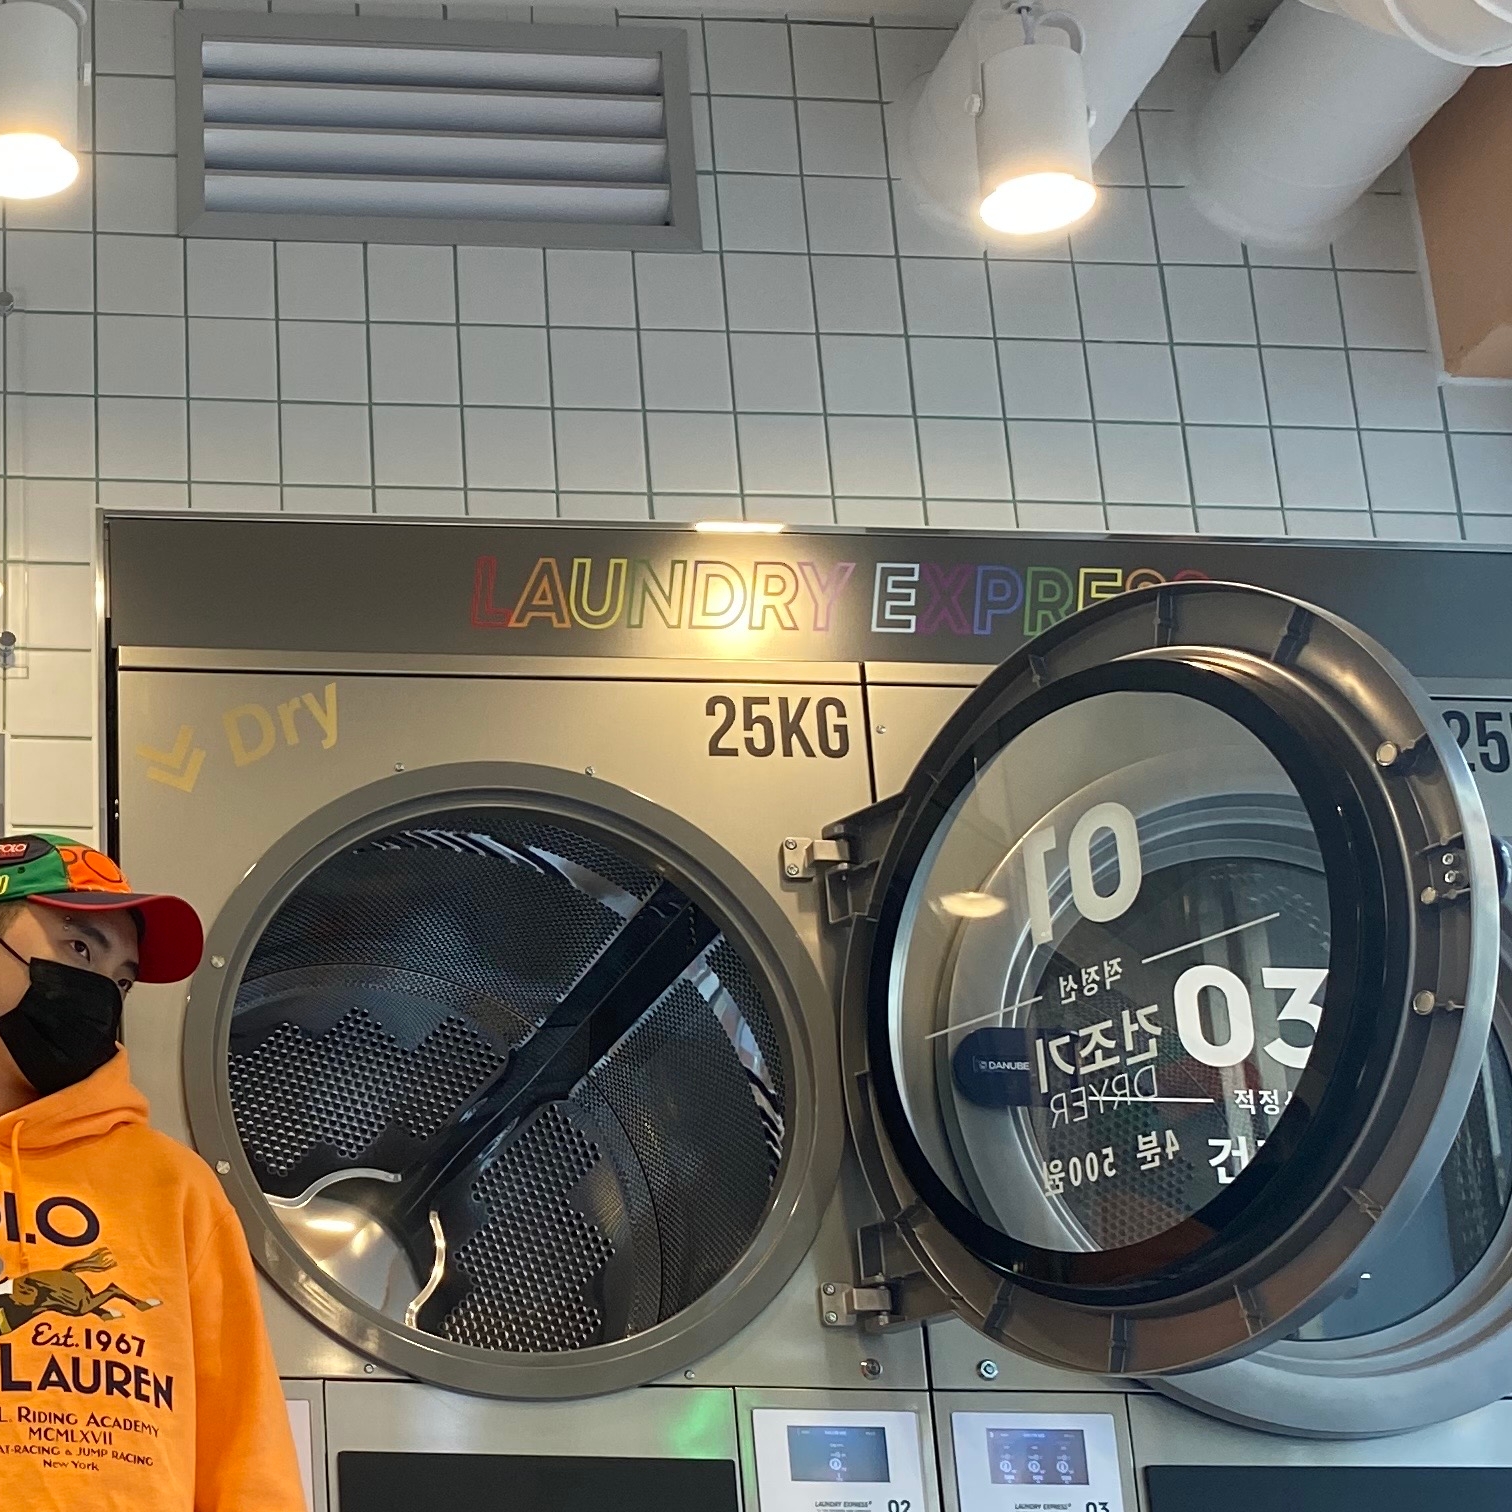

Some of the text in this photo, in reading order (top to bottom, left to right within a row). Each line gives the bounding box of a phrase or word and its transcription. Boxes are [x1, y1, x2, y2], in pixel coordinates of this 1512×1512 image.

[470, 556, 1210, 635] LAUNDRY EXPRE
[222, 682, 338, 768] Dry
[705, 695, 849, 759] 25KG
[1174, 964, 1329, 1069] 03
[988, 1060, 1030, 1072] DANUBE
[1233, 1089, 1293, 1115] 적정
[32, 1322, 145, 1357] Est. 1967
[0, 1343, 173, 1411] LAUREN
[18, 1406, 78, 1424] RIDING
[86, 1412, 159, 1438] ACADEMY
[29, 1427, 112, 1445] MCMLXVII
[43, 1459, 100, 1471] New York
[77, 1447, 108, 1458] JUMP
[112, 1450, 153, 1466] RACING
